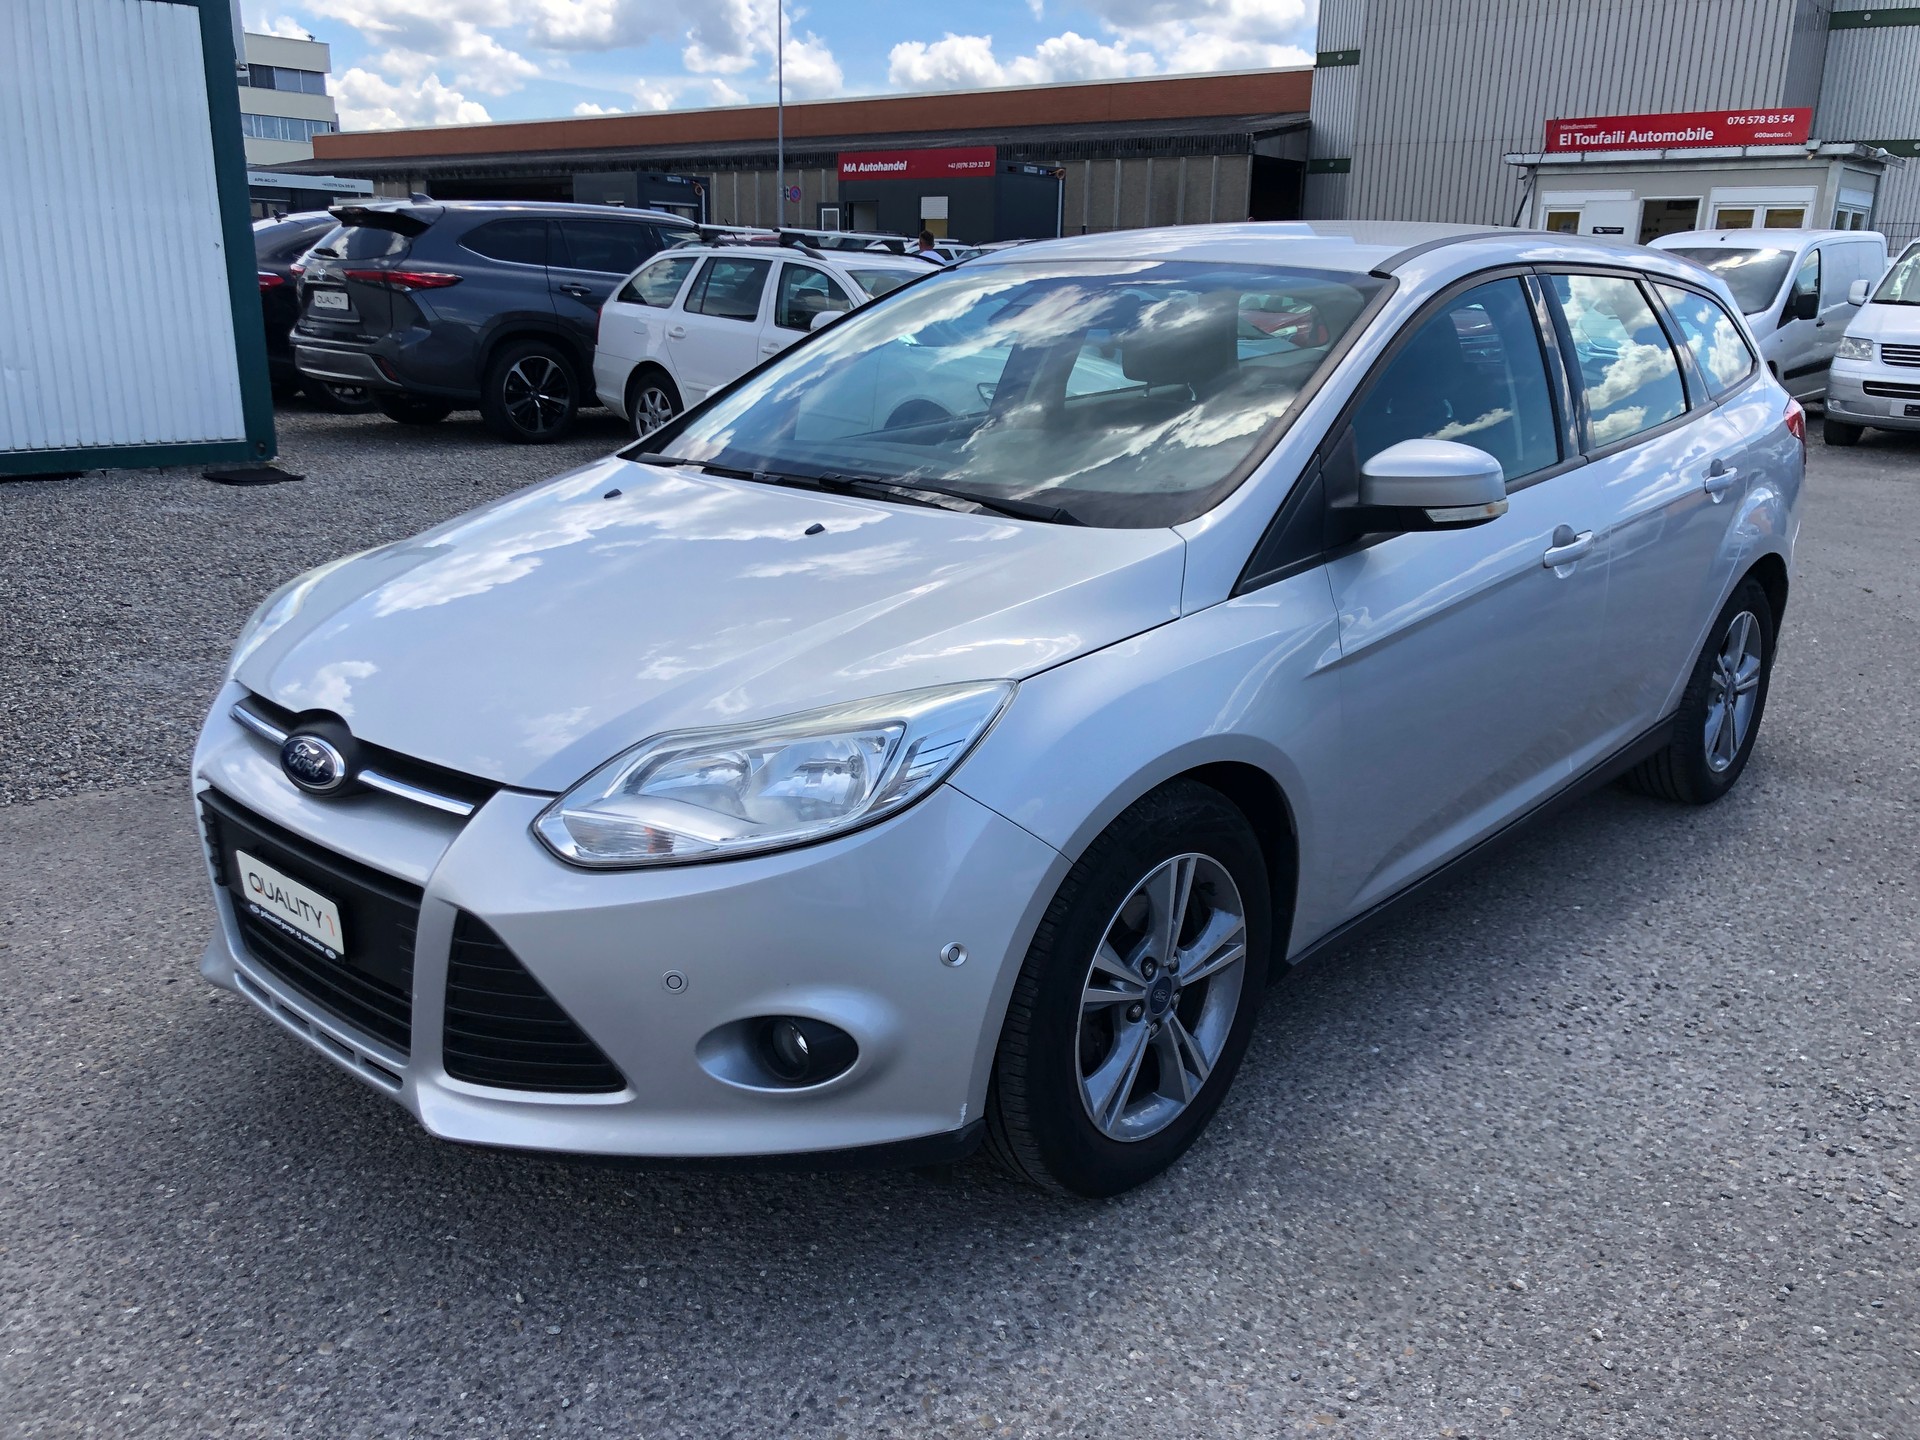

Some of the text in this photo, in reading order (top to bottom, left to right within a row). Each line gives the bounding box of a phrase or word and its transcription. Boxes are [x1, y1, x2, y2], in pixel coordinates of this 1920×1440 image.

[1727, 114, 1795, 125] 076 578 85 54
[1559, 127, 1714, 146] El Toufaili Automobile
[1754, 131, 1793, 139] 600autos.ch
[843, 160, 908, 173] MA Autohandel
[288, 742, 326, 777] Ford
